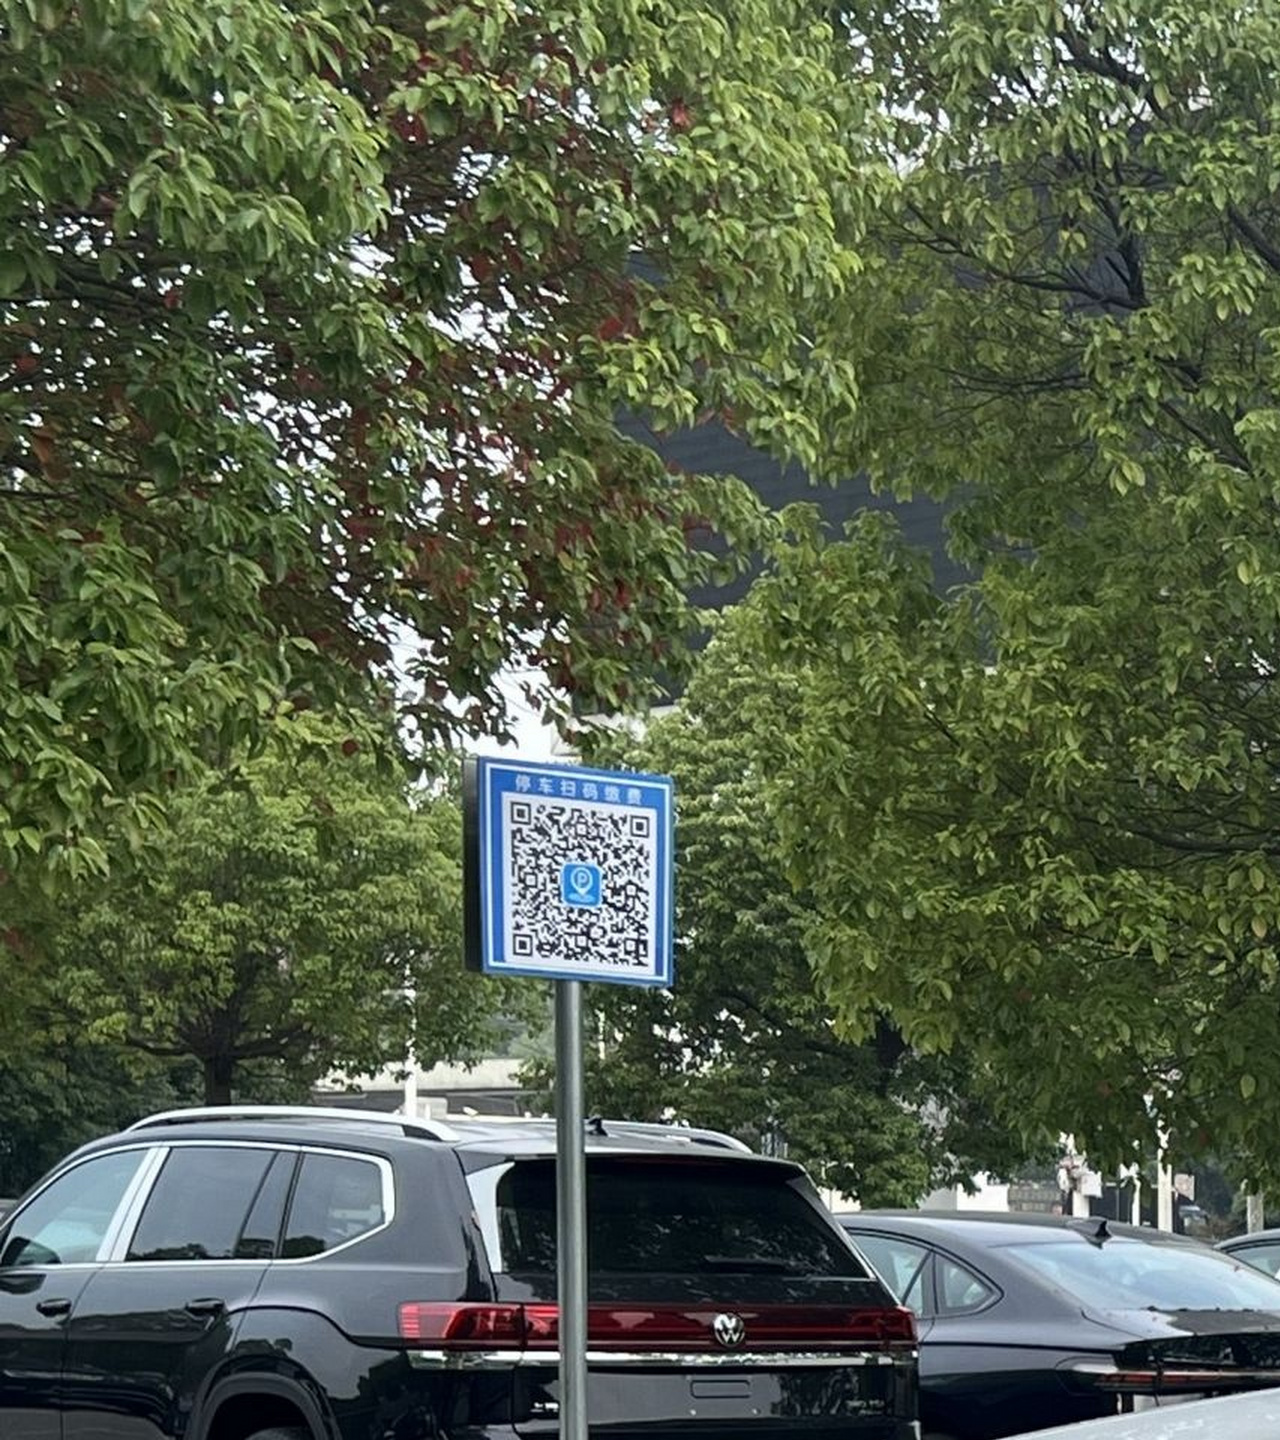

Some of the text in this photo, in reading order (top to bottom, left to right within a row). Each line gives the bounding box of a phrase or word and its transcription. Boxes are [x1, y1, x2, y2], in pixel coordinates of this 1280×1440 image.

[515, 773, 643, 805] 停车扫码缴费
